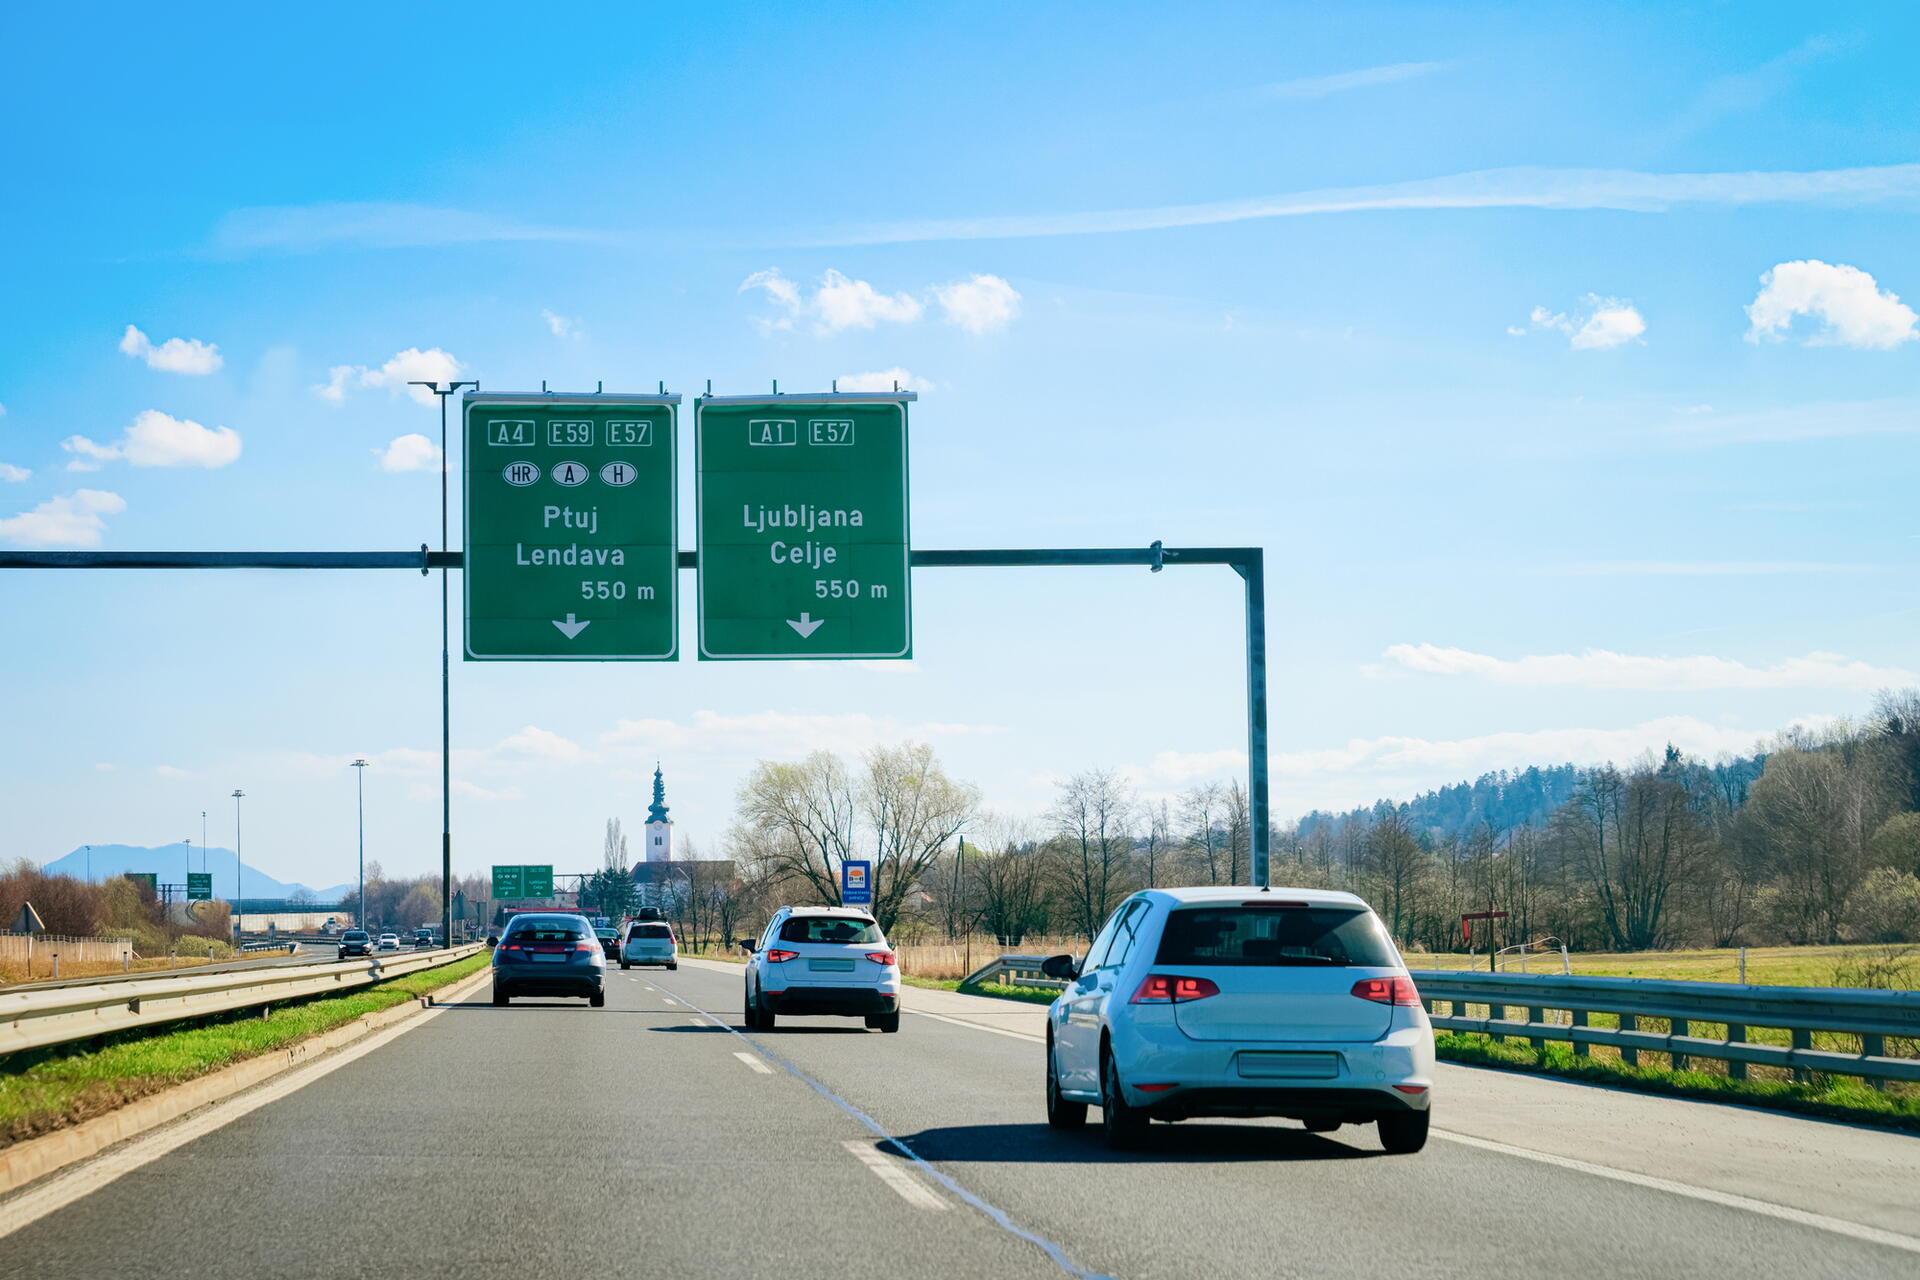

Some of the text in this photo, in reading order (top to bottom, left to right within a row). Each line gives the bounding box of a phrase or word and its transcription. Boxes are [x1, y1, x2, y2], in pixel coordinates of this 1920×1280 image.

[497, 423, 648, 443] A4 E59 E57
[761, 423, 850, 443] A1 E57
[511, 465, 624, 483] HR A H
[543, 505, 598, 534] Ptuj
[743, 504, 863, 533] Ljubljana
[516, 542, 625, 566] Lendava
[770, 541, 837, 569] Celje
[581, 581, 655, 600] 550 m
[815, 580, 888, 598] 550 m
